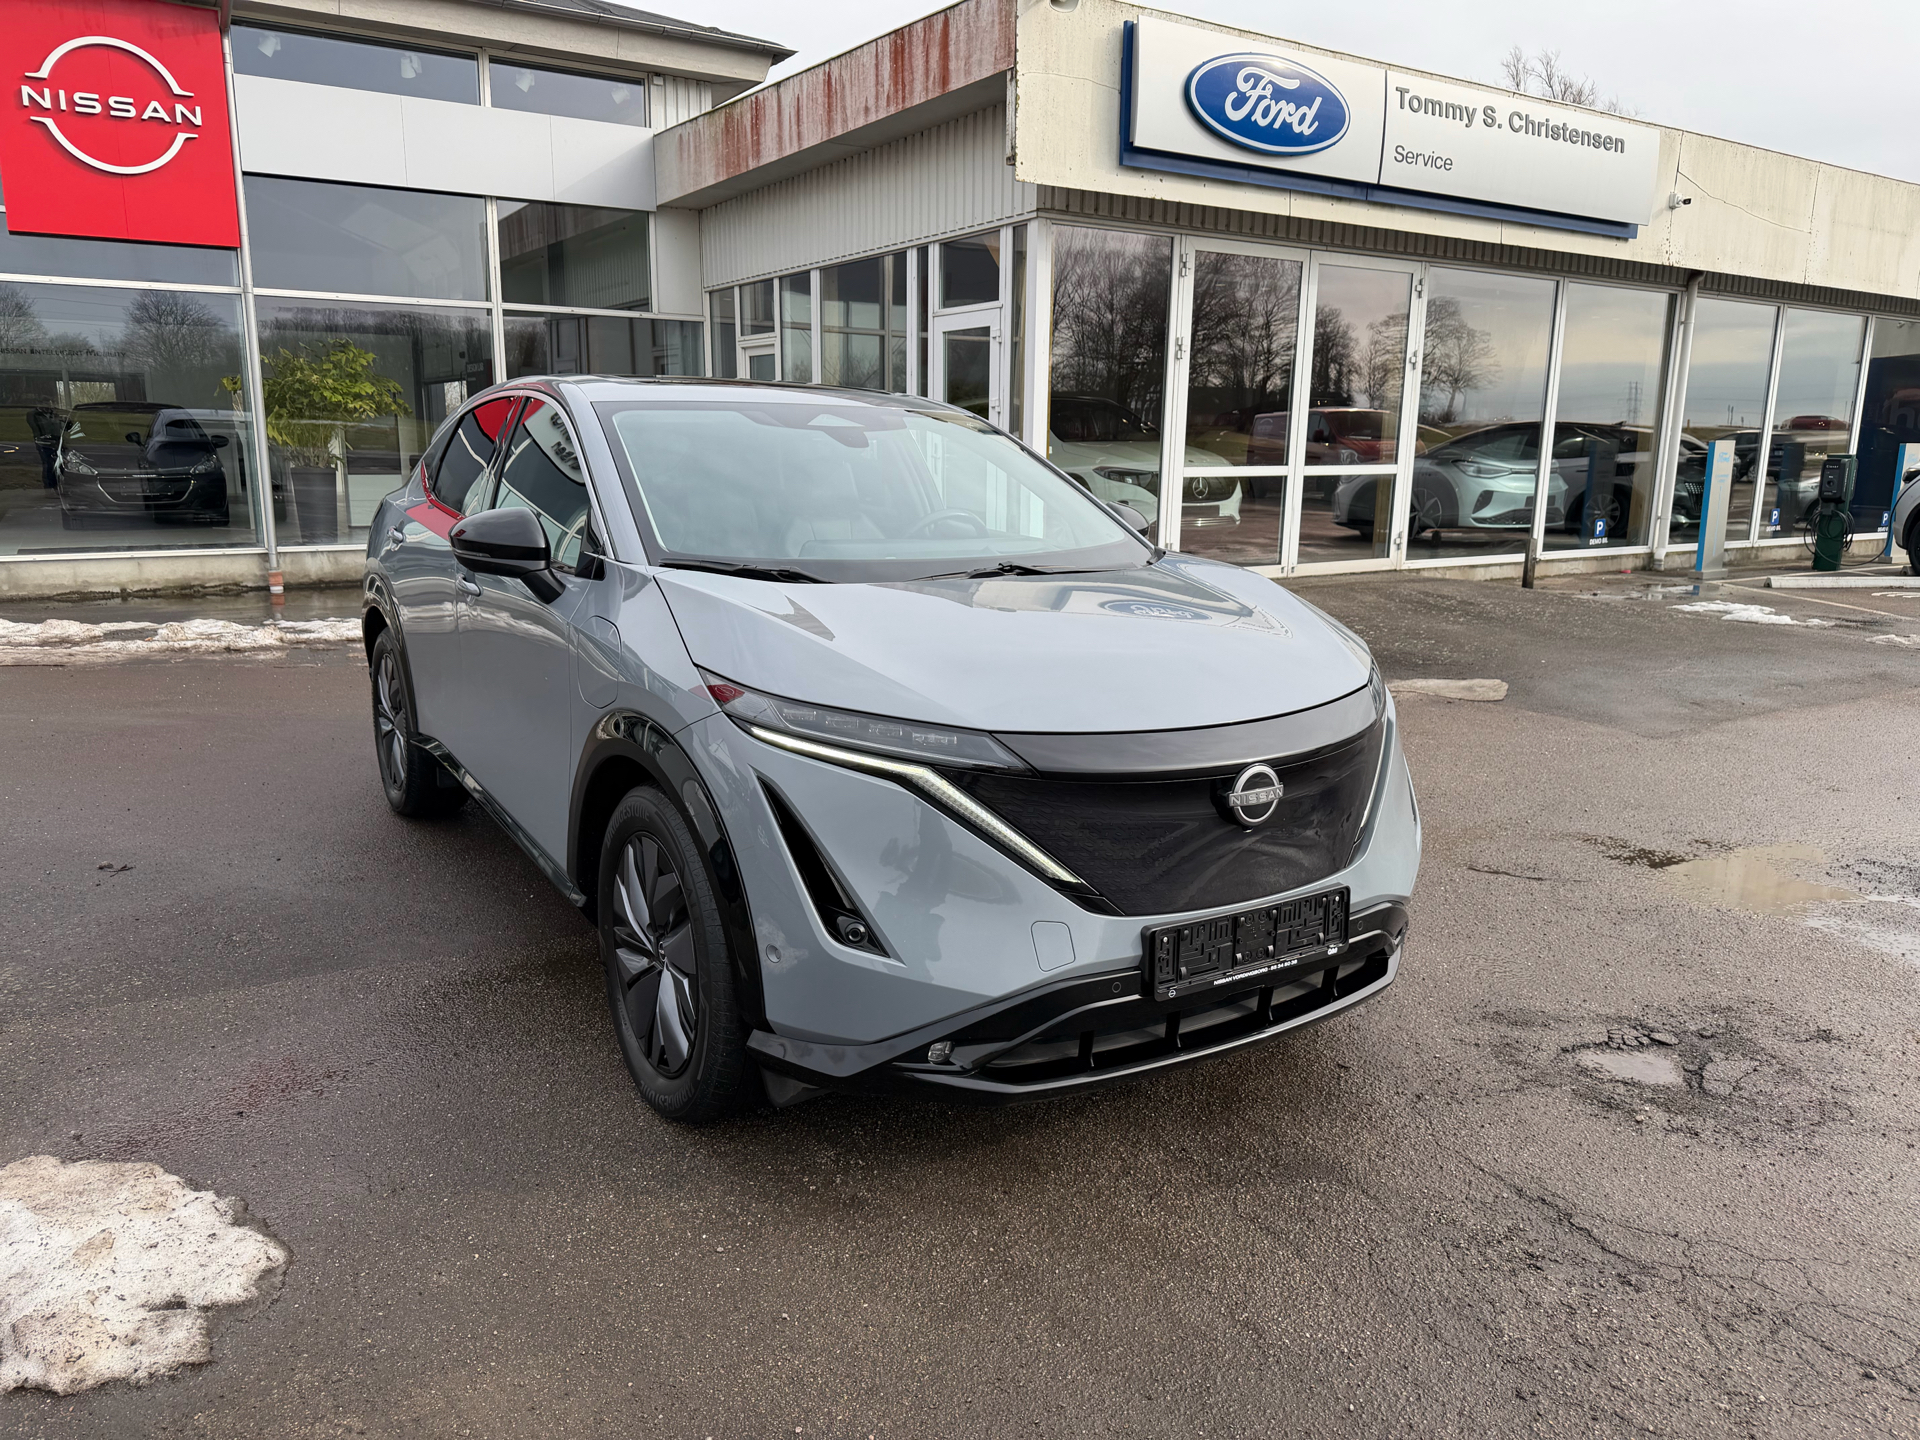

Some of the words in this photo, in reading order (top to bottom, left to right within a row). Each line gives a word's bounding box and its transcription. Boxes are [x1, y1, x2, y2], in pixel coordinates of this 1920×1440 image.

[20, 85, 202, 127] NISSAN
[1224, 66, 1322, 136] Ford
[1396, 86, 1477, 128] Tommy
[1483, 105, 1503, 130] S.
[1508, 111, 1626, 154] Christensen
[1394, 144, 1454, 172] Service
[1596, 521, 1604, 535] P
[1772, 510, 1779, 523] P
[1231, 787, 1284, 806] NISSAN
